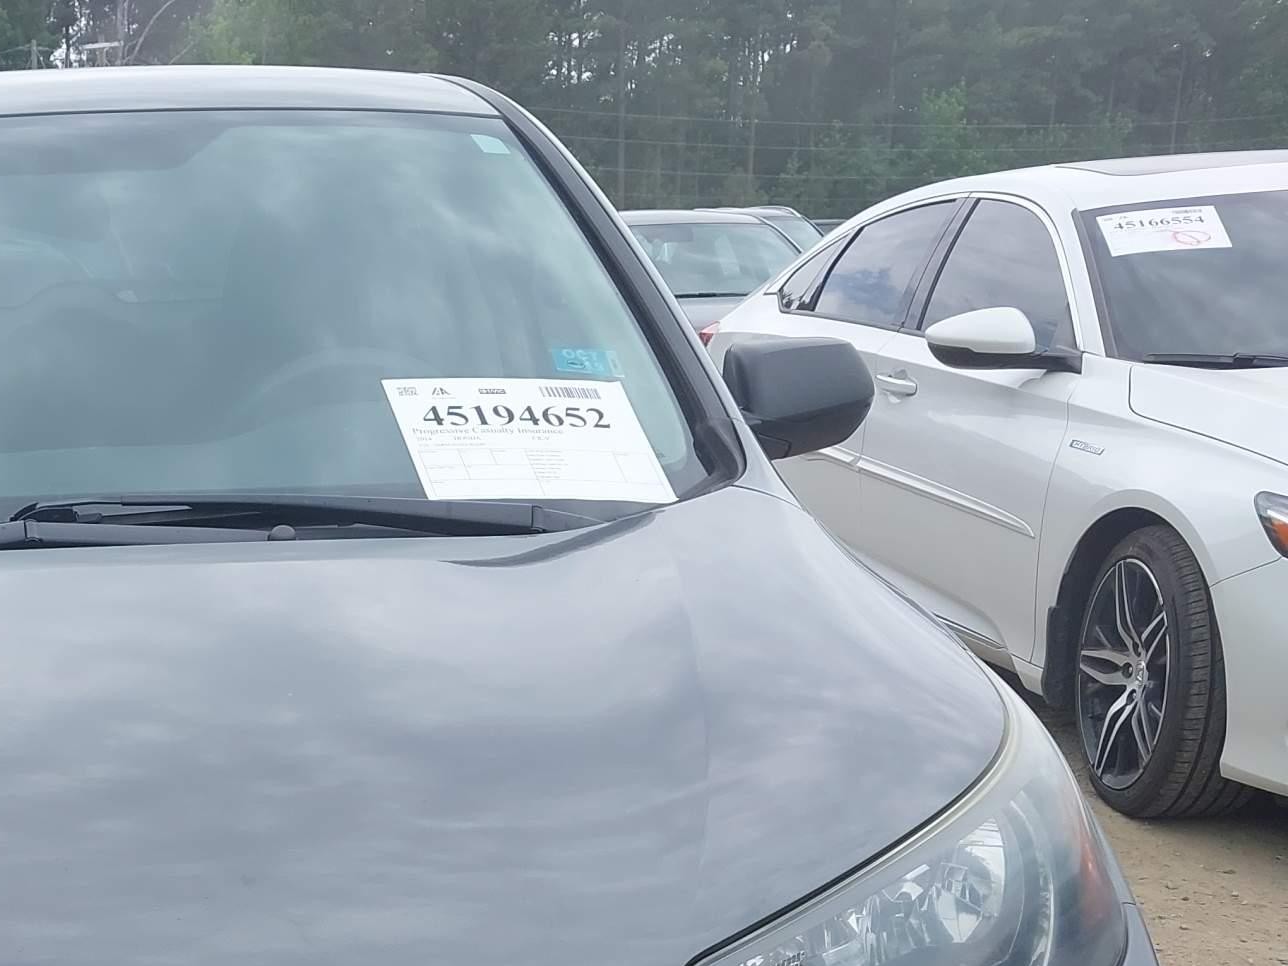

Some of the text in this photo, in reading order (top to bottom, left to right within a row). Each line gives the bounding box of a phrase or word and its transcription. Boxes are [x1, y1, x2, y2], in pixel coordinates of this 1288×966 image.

[1114, 215, 1205, 230] 45166554
[423, 405, 611, 429] 45194652
[412, 427, 564, 436] Progressive Casualty Insurance
